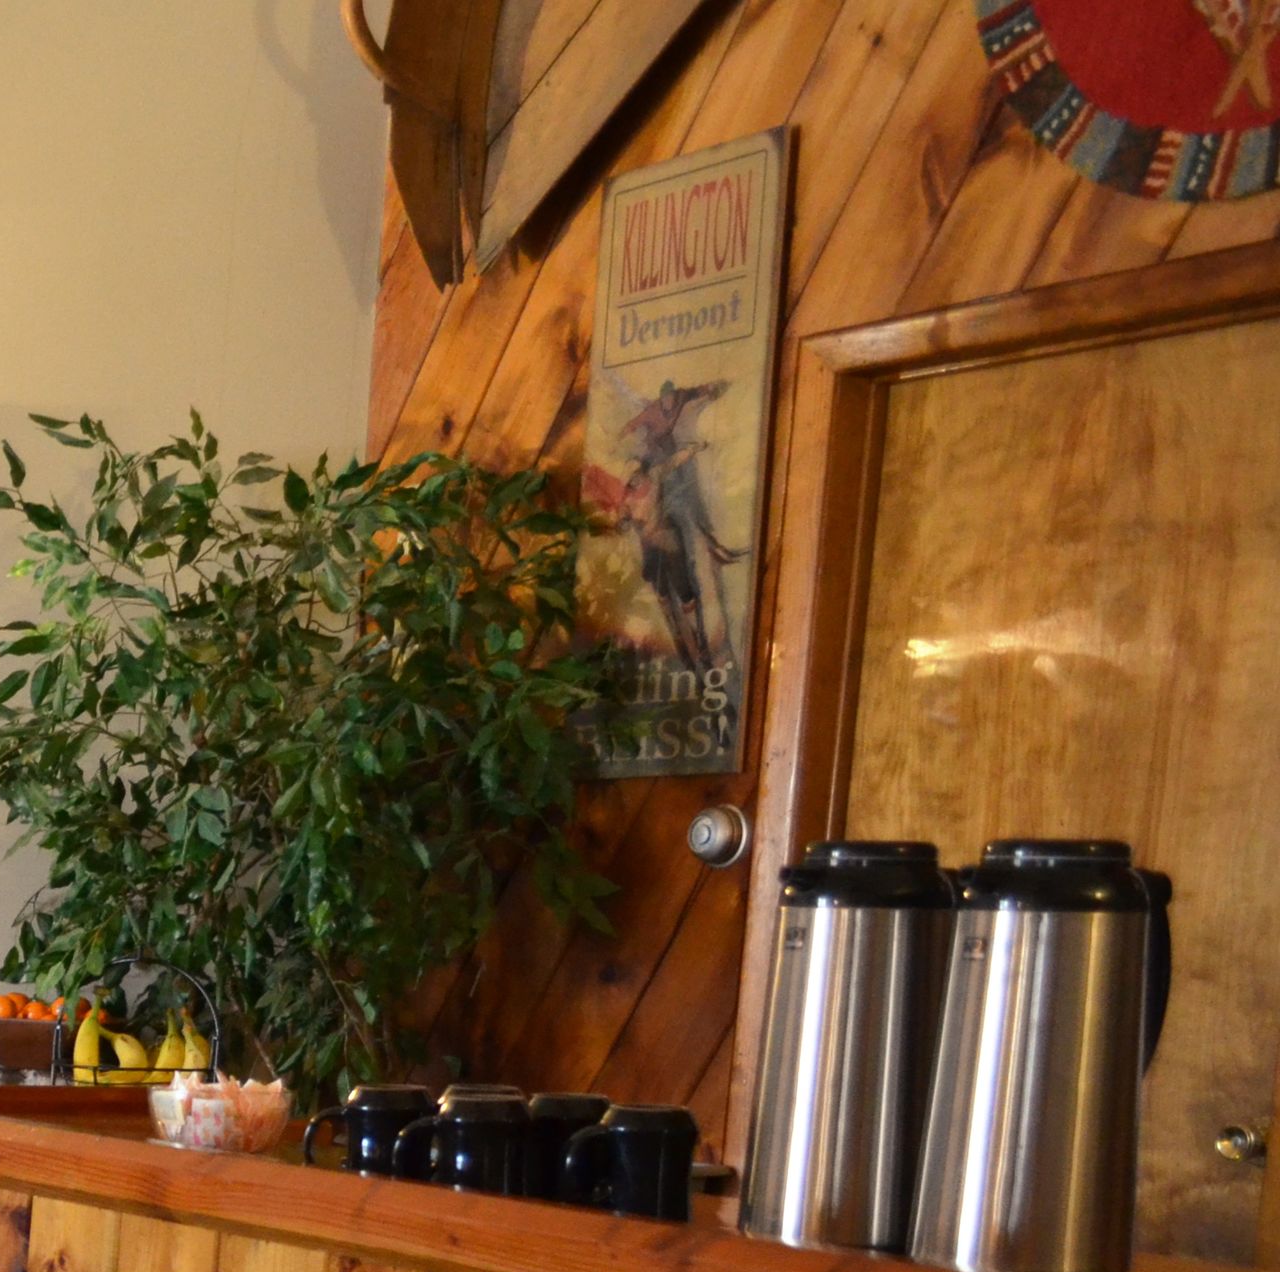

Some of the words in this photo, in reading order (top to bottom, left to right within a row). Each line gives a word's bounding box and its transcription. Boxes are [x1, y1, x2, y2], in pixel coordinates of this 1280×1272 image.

[620, 169, 753, 297] KILLINGTON
[619, 289, 741, 348] Vermont
[605, 655, 733, 712] iing
